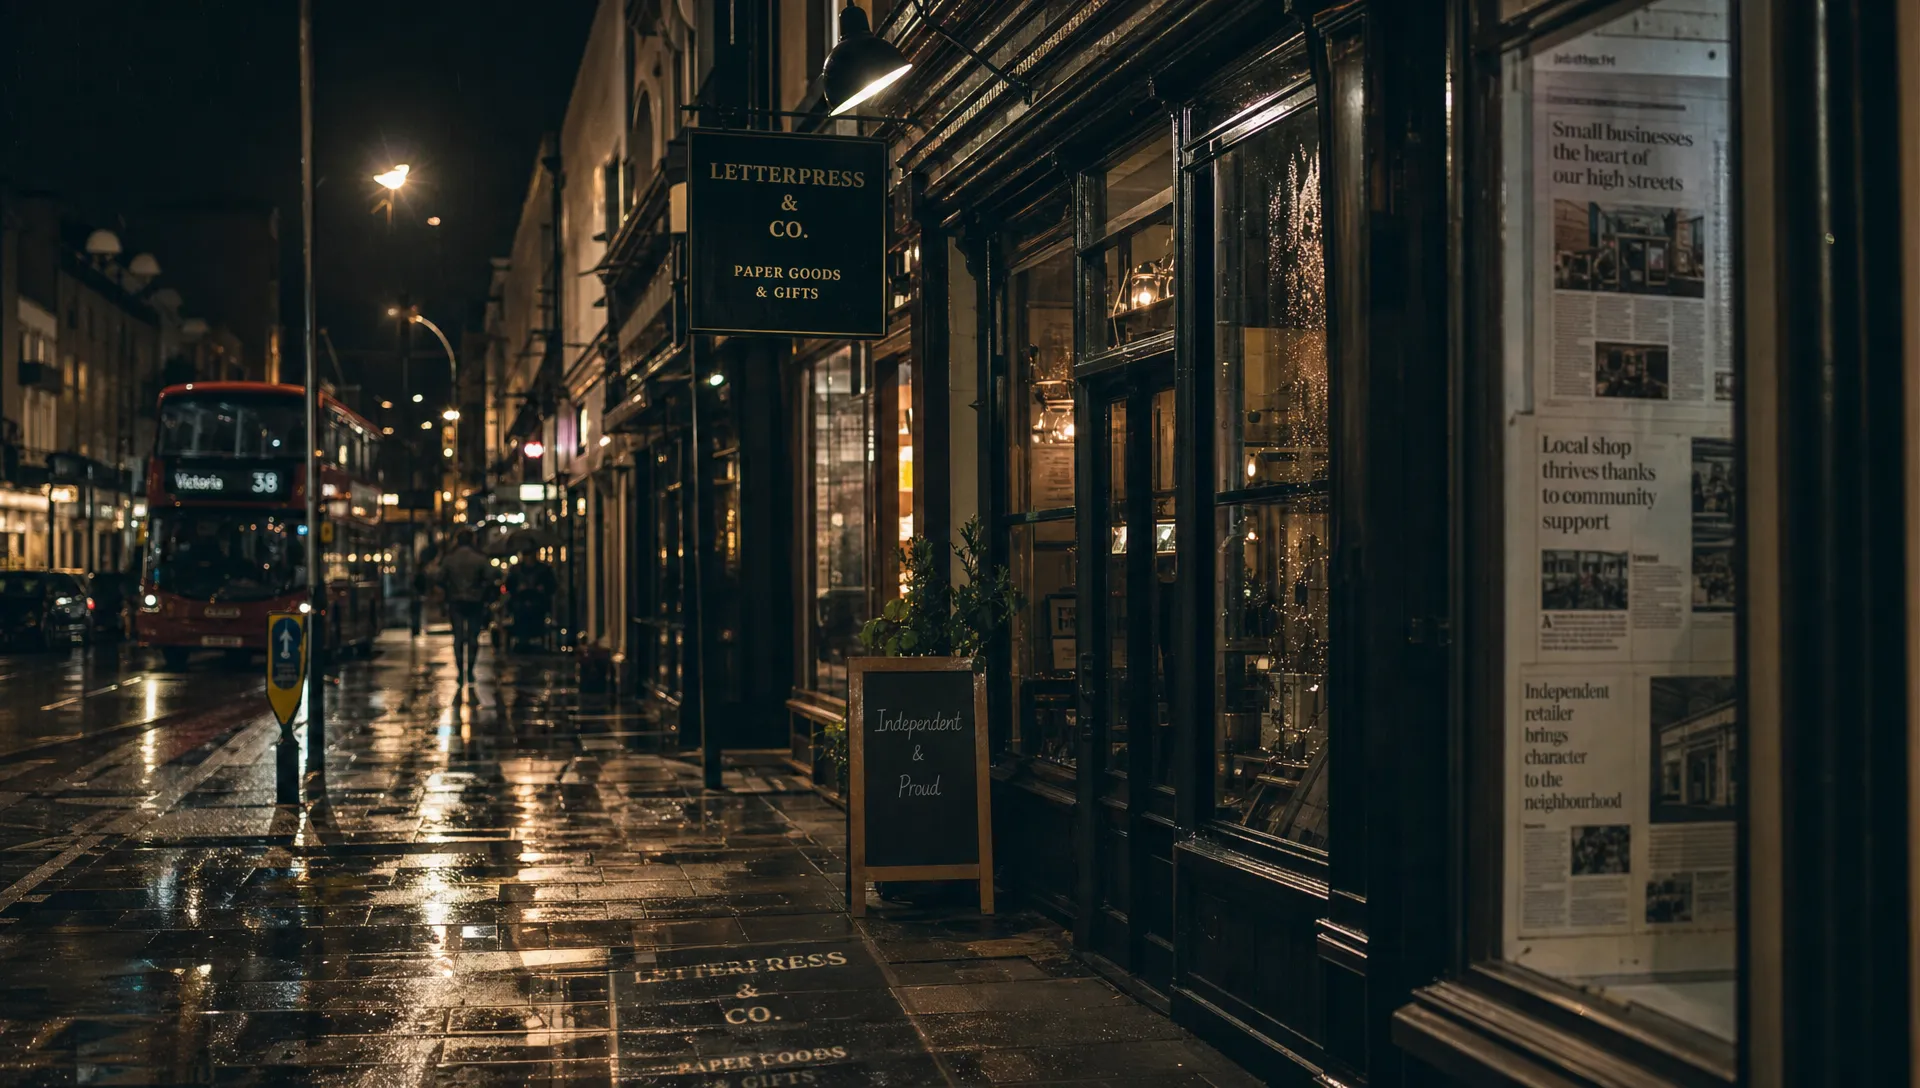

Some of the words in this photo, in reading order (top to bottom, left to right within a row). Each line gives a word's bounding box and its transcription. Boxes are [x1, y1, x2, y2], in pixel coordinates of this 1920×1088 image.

[1553, 120, 1601, 140] Small
[1606, 125, 1693, 147] businesses
[1553, 143, 1580, 162] the
[1584, 144, 1629, 165] heart
[1632, 148, 1651, 166] of
[710, 162, 865, 188] LETTERPRESS
[1553, 170, 1584, 185] our
[1587, 168, 1624, 191] high
[1627, 175, 1684, 192] streets
[781, 194, 798, 211] &
[769, 220, 808, 238] CO.
[734, 265, 784, 279] PAPER
[788, 267, 841, 281] GOODS
[756, 286, 767, 298] &
[774, 287, 819, 299] GIFTS
[1542, 435, 1588, 454] Local
[1592, 436, 1632, 460] shop
[1542, 461, 1598, 480] thrives
[1601, 462, 1656, 481] thanks
[174, 472, 224, 490] Victoria
[252, 472, 278, 493] 38
[1542, 488, 1560, 504] to
[1562, 488, 1657, 509] community
[1542, 513, 1611, 534] support
[1525, 682, 1609, 702] Independent
[1525, 705, 1574, 721] retailer
[875, 709, 962, 740] Independent
[1525, 727, 1568, 745] brings
[912, 744, 924, 761] &
[1525, 749, 1588, 765] character
[899, 773, 941, 797] Proud
[1525, 773, 1539, 787] to
[1541, 771, 1563, 787] the
[1525, 792, 1622, 814] neighbourhood
[735, 983, 760, 999] &
[725, 1006, 782, 1024] CO.
[678, 1055, 753, 1075] PAPER
[741, 1070, 817, 1088] GIFTS
